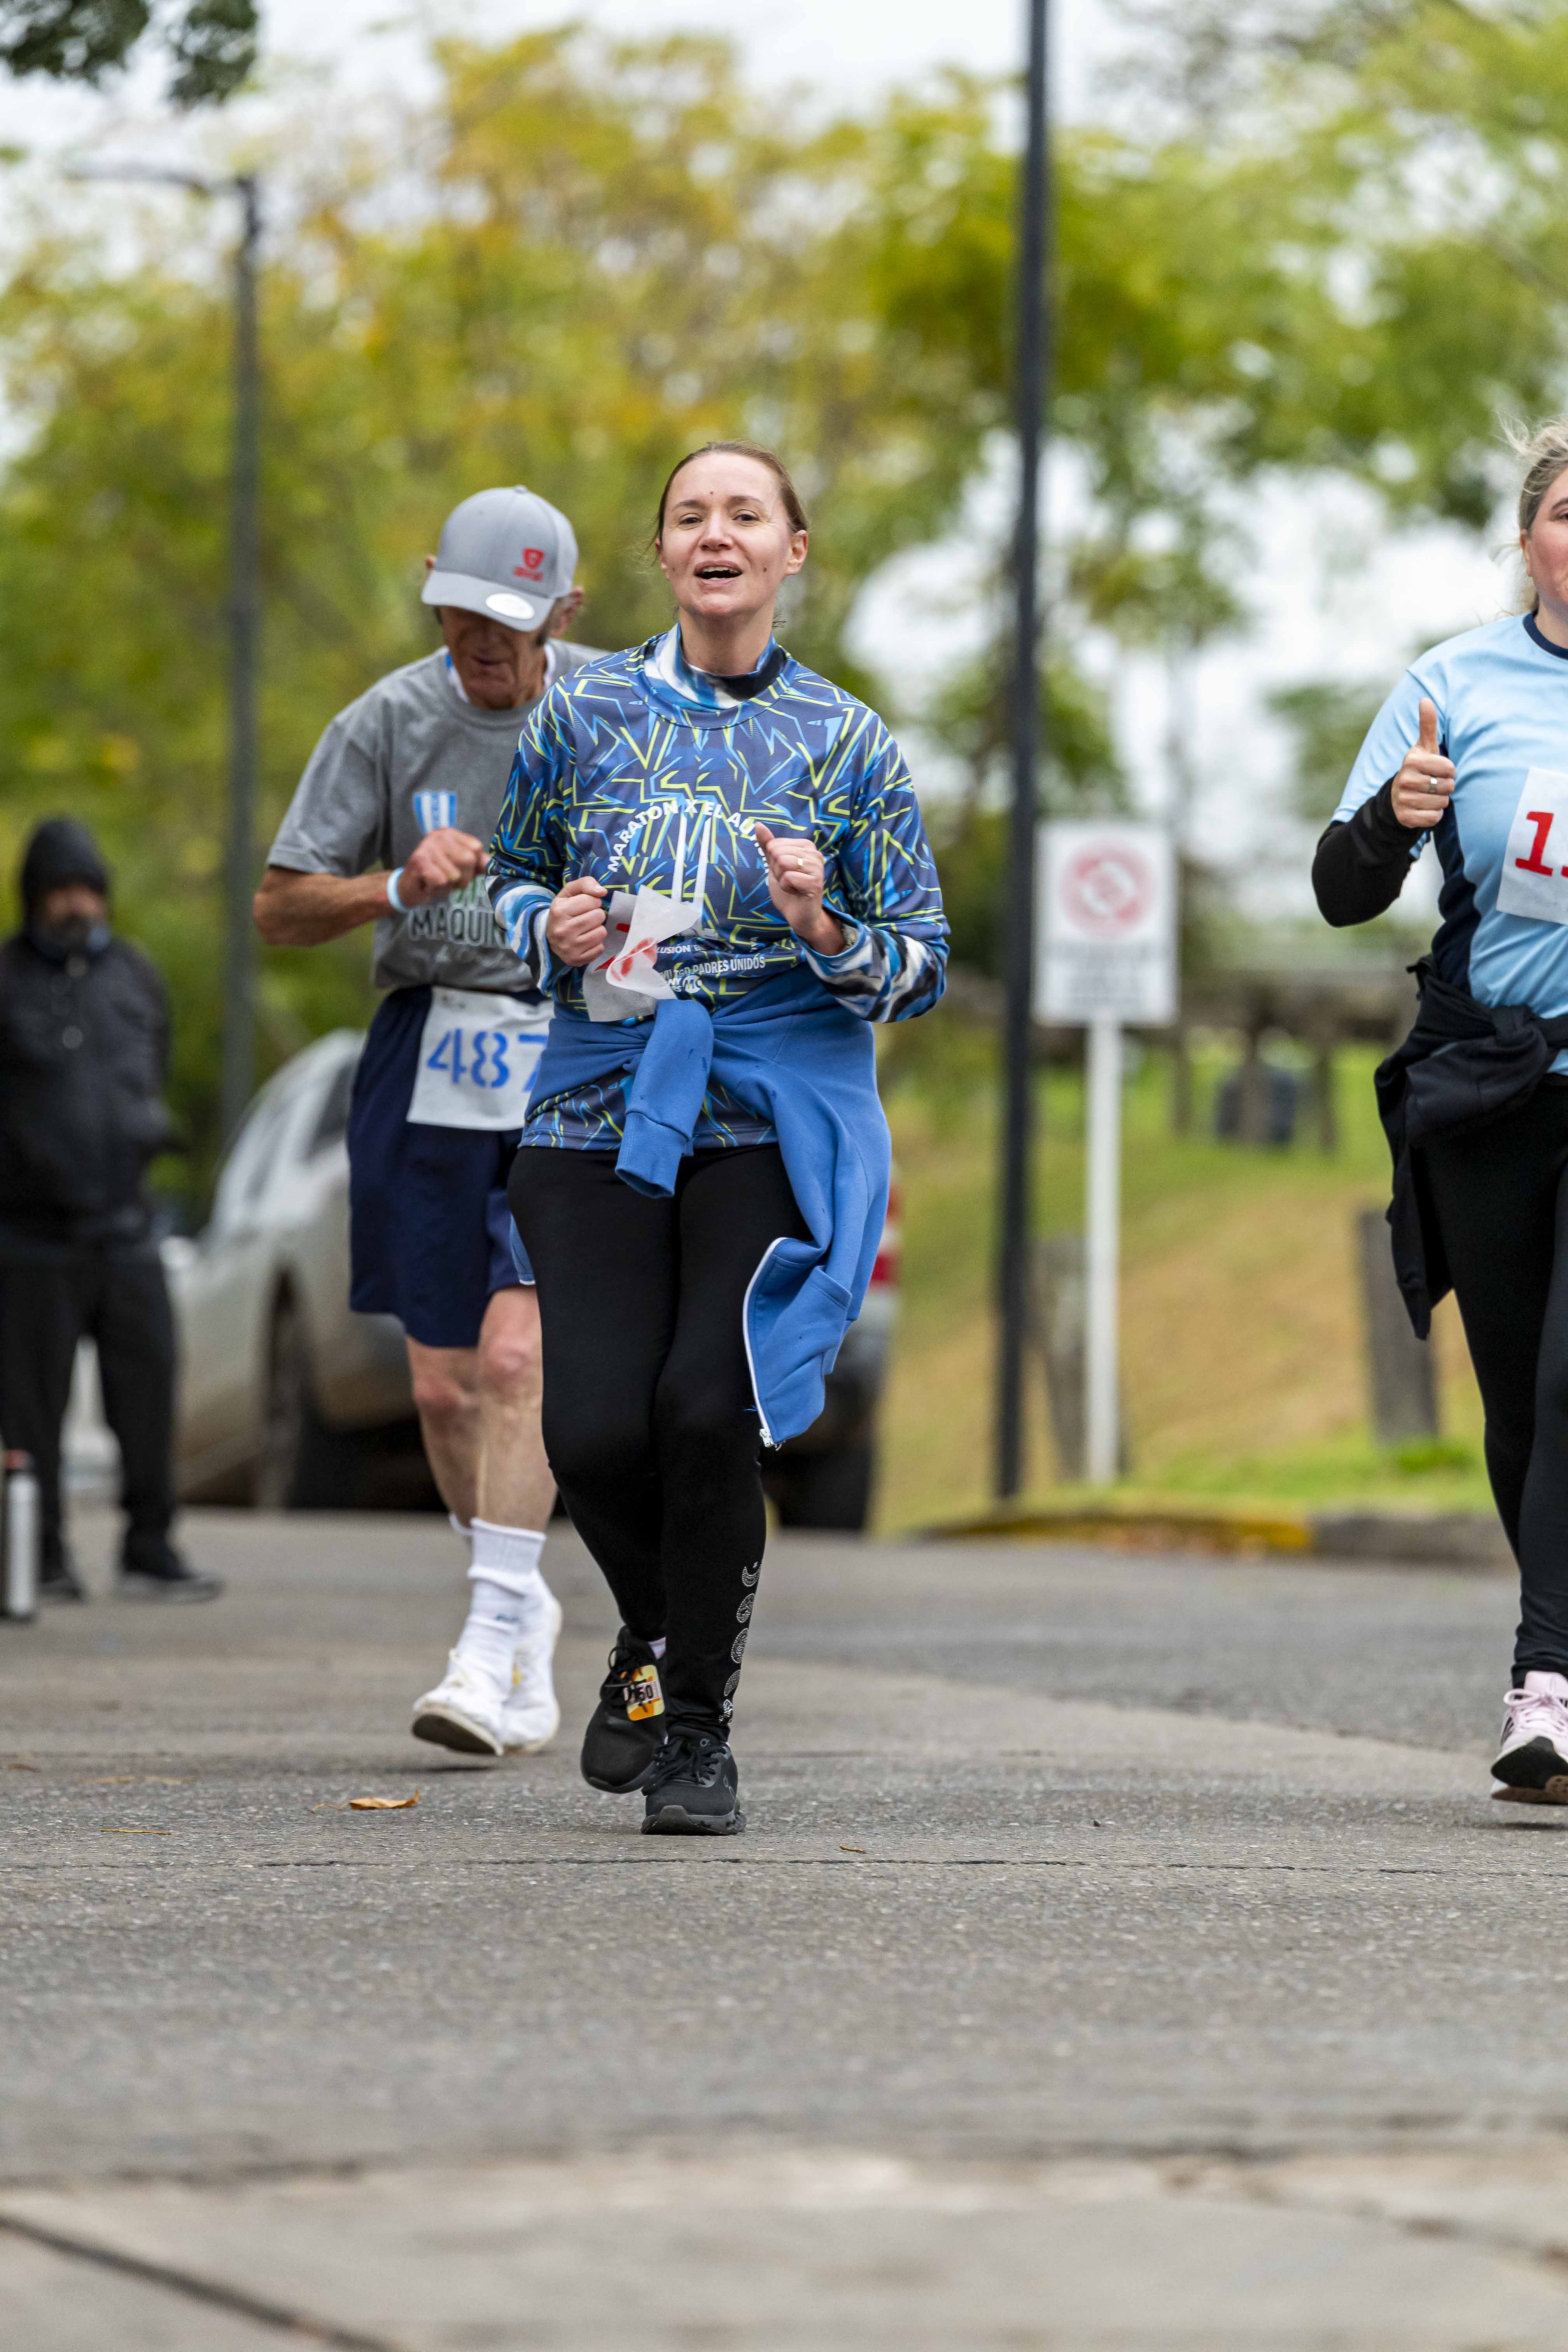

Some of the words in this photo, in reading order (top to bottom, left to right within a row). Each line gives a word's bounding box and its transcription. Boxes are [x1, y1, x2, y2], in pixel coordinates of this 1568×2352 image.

[607, 800, 679, 873] MARATÓN
[684, 799, 698, 813] X
[703, 800, 723, 819] EL
[1515, 811, 1568, 878] 1
[656, 944, 691, 954] LUSIÓN
[692, 959, 729, 973] PADRES
[730, 956, 766, 971] UNIDOS
[426, 1028, 548, 1092] 487
